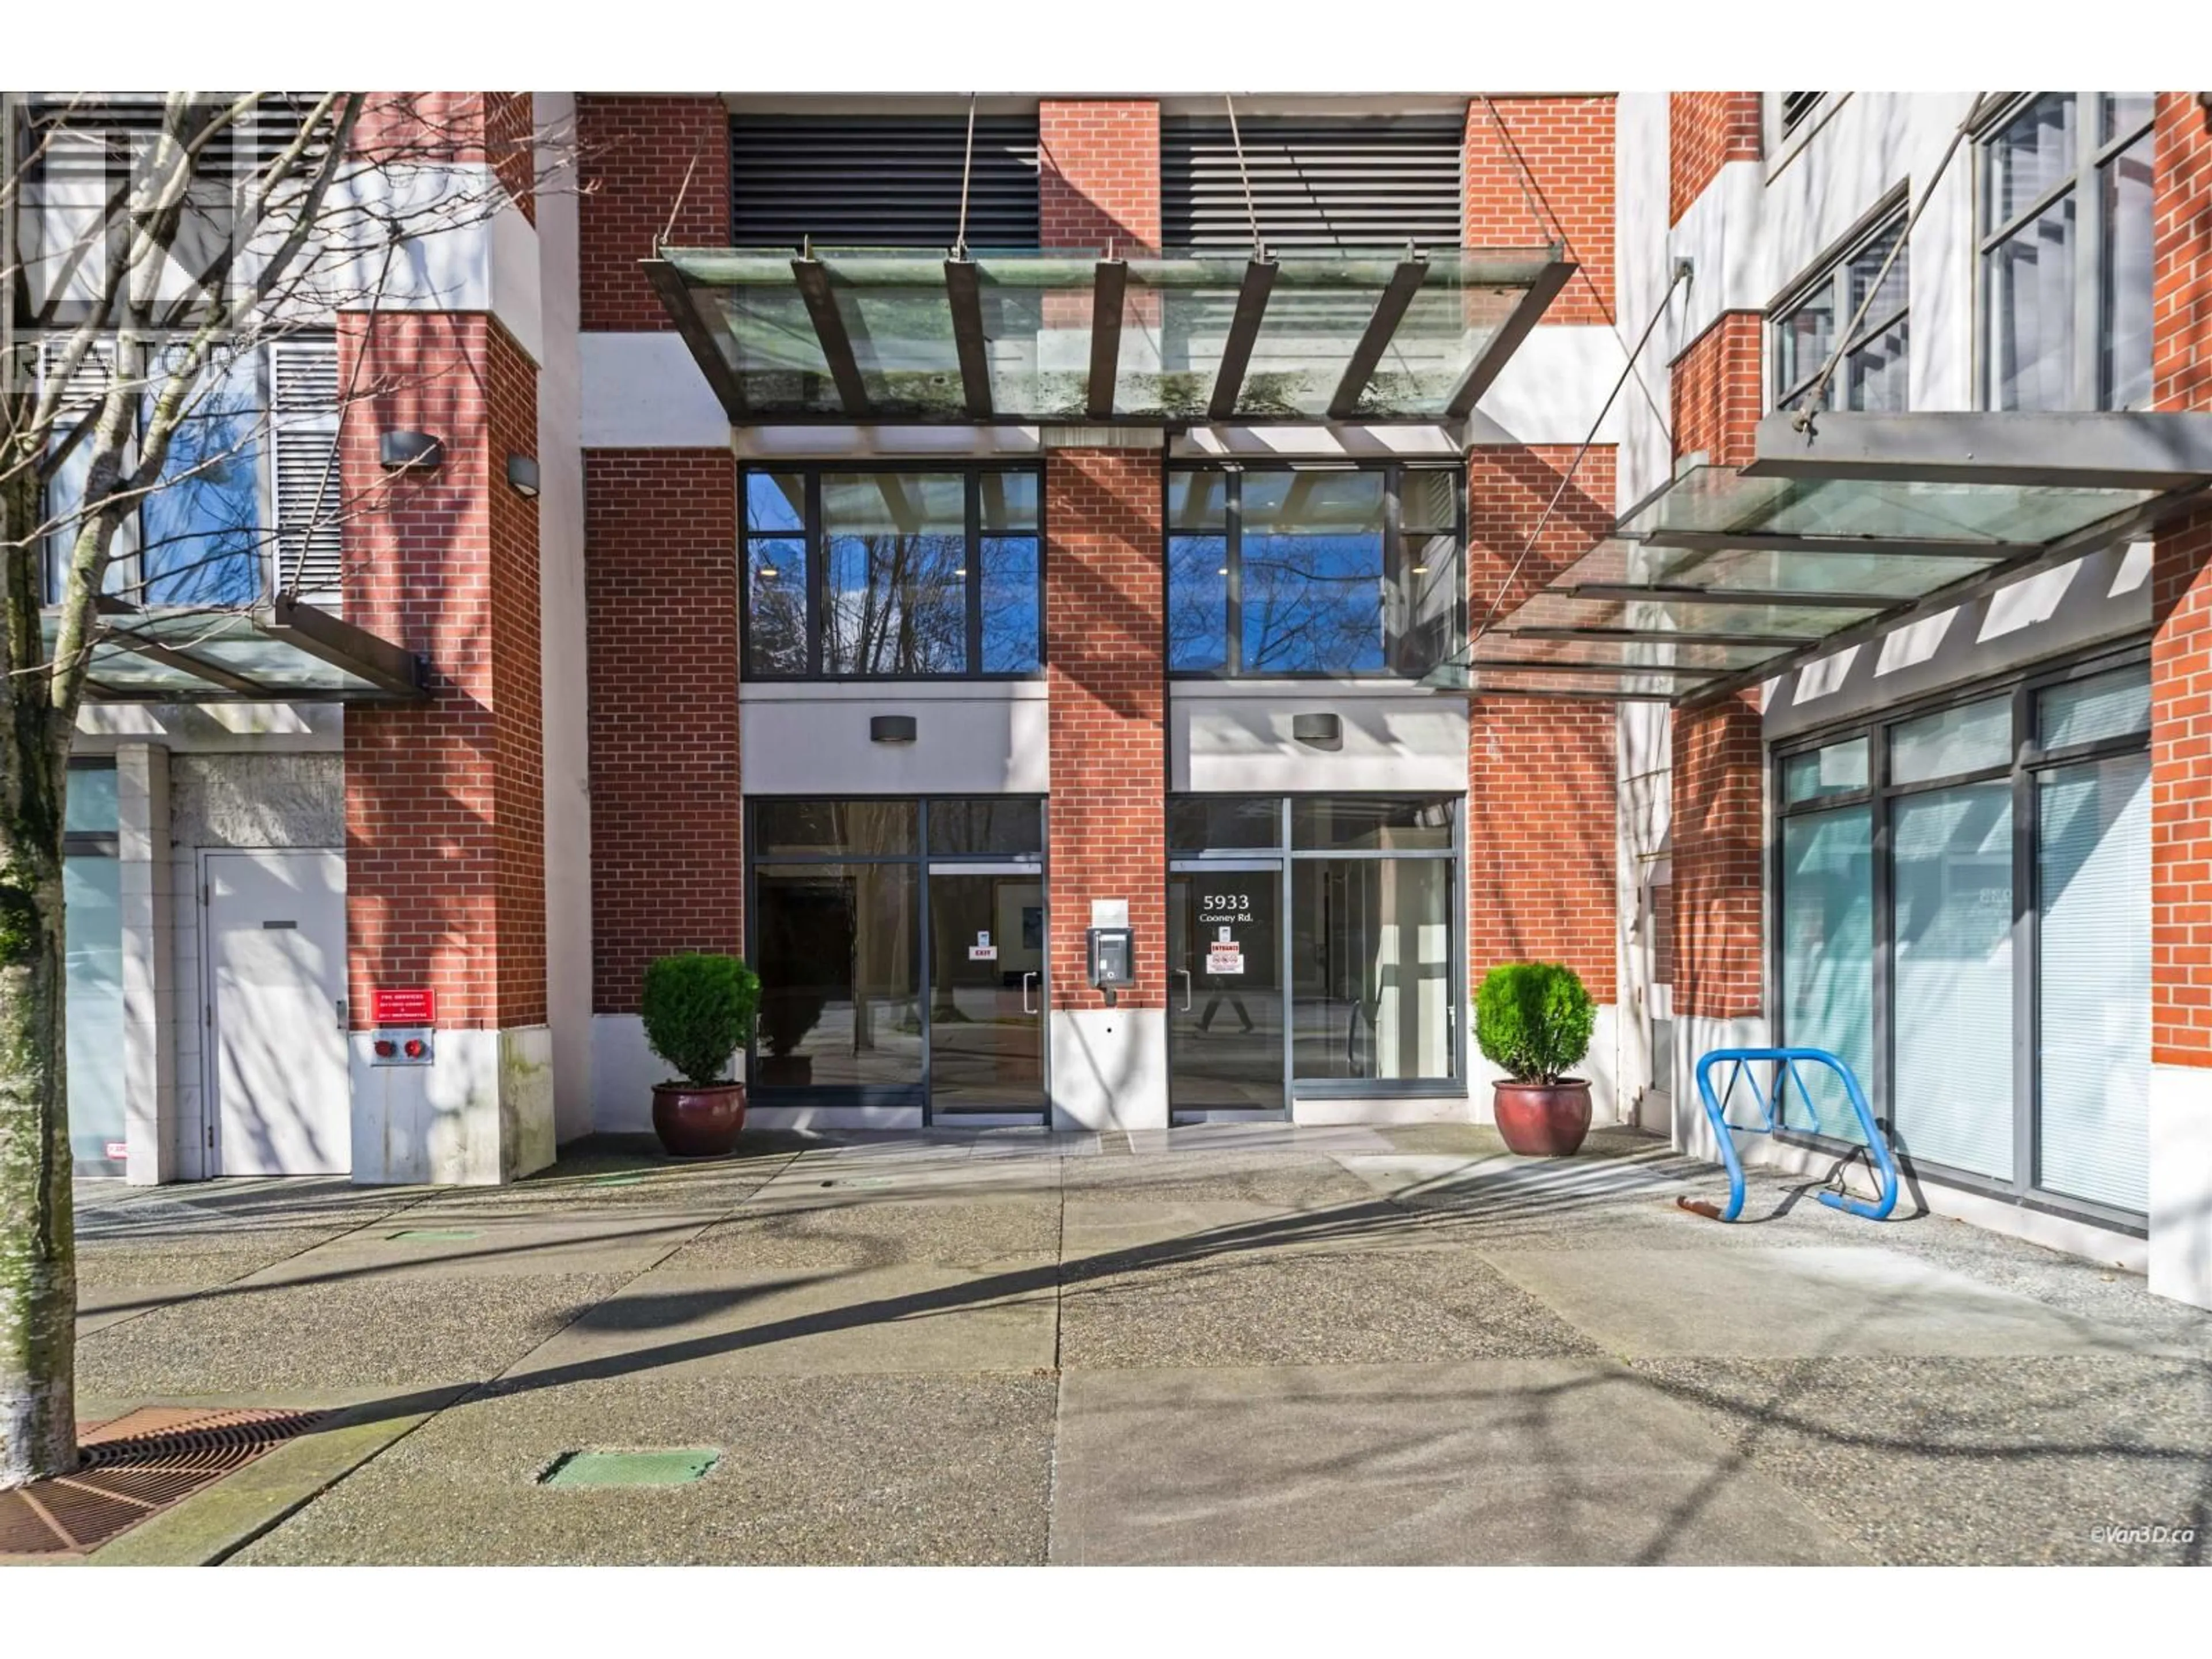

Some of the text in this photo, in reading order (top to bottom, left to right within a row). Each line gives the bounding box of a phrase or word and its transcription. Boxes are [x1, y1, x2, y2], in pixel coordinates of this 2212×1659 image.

[1203, 895, 1249, 910] 5933
[1199, 912, 1253, 923] Cooney Rd.
